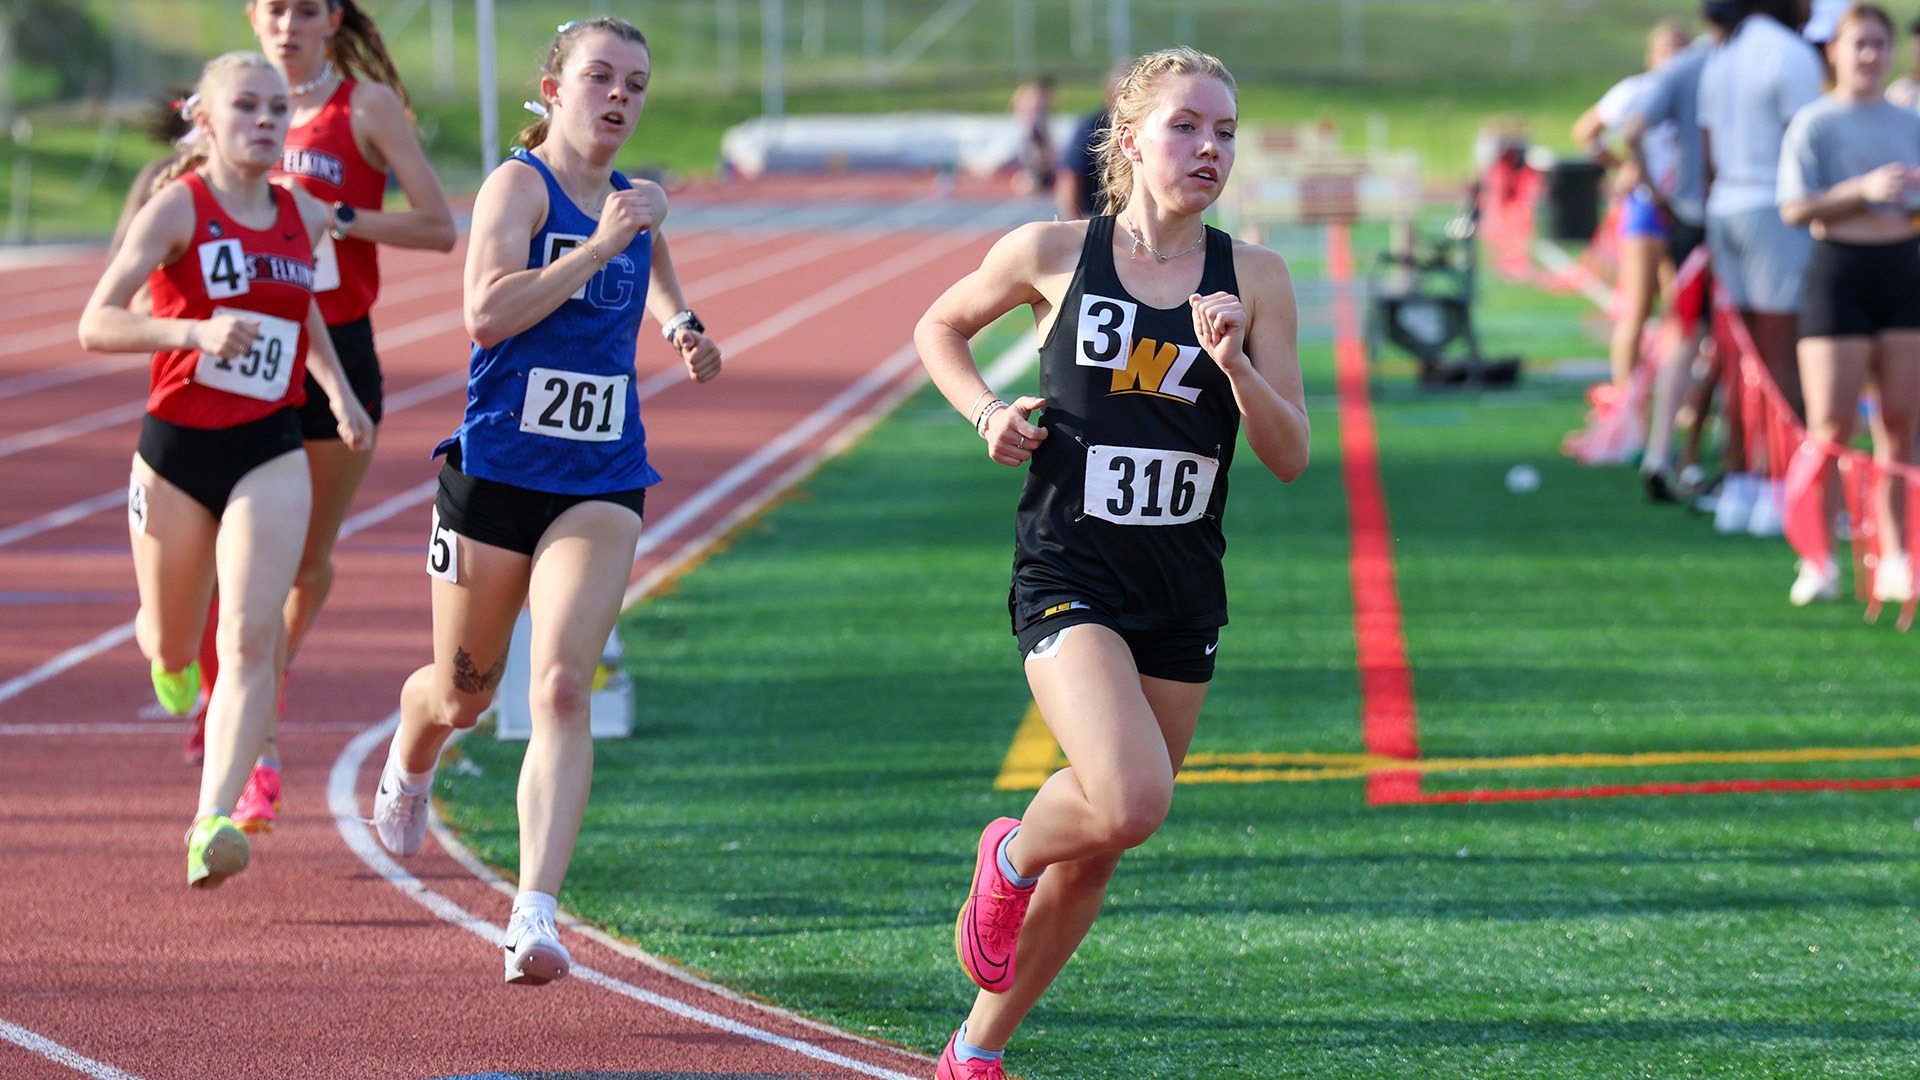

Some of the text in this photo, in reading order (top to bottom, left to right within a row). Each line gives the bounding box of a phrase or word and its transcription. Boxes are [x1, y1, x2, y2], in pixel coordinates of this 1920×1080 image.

[283, 150, 343, 185] ELKINS
[211, 245, 240, 289] 4
[1083, 301, 1125, 362] 3
[1109, 337, 1203, 404] WL
[538, 377, 615, 432] 261
[1106, 456, 1198, 517] 316
[432, 519, 450, 573] 5
